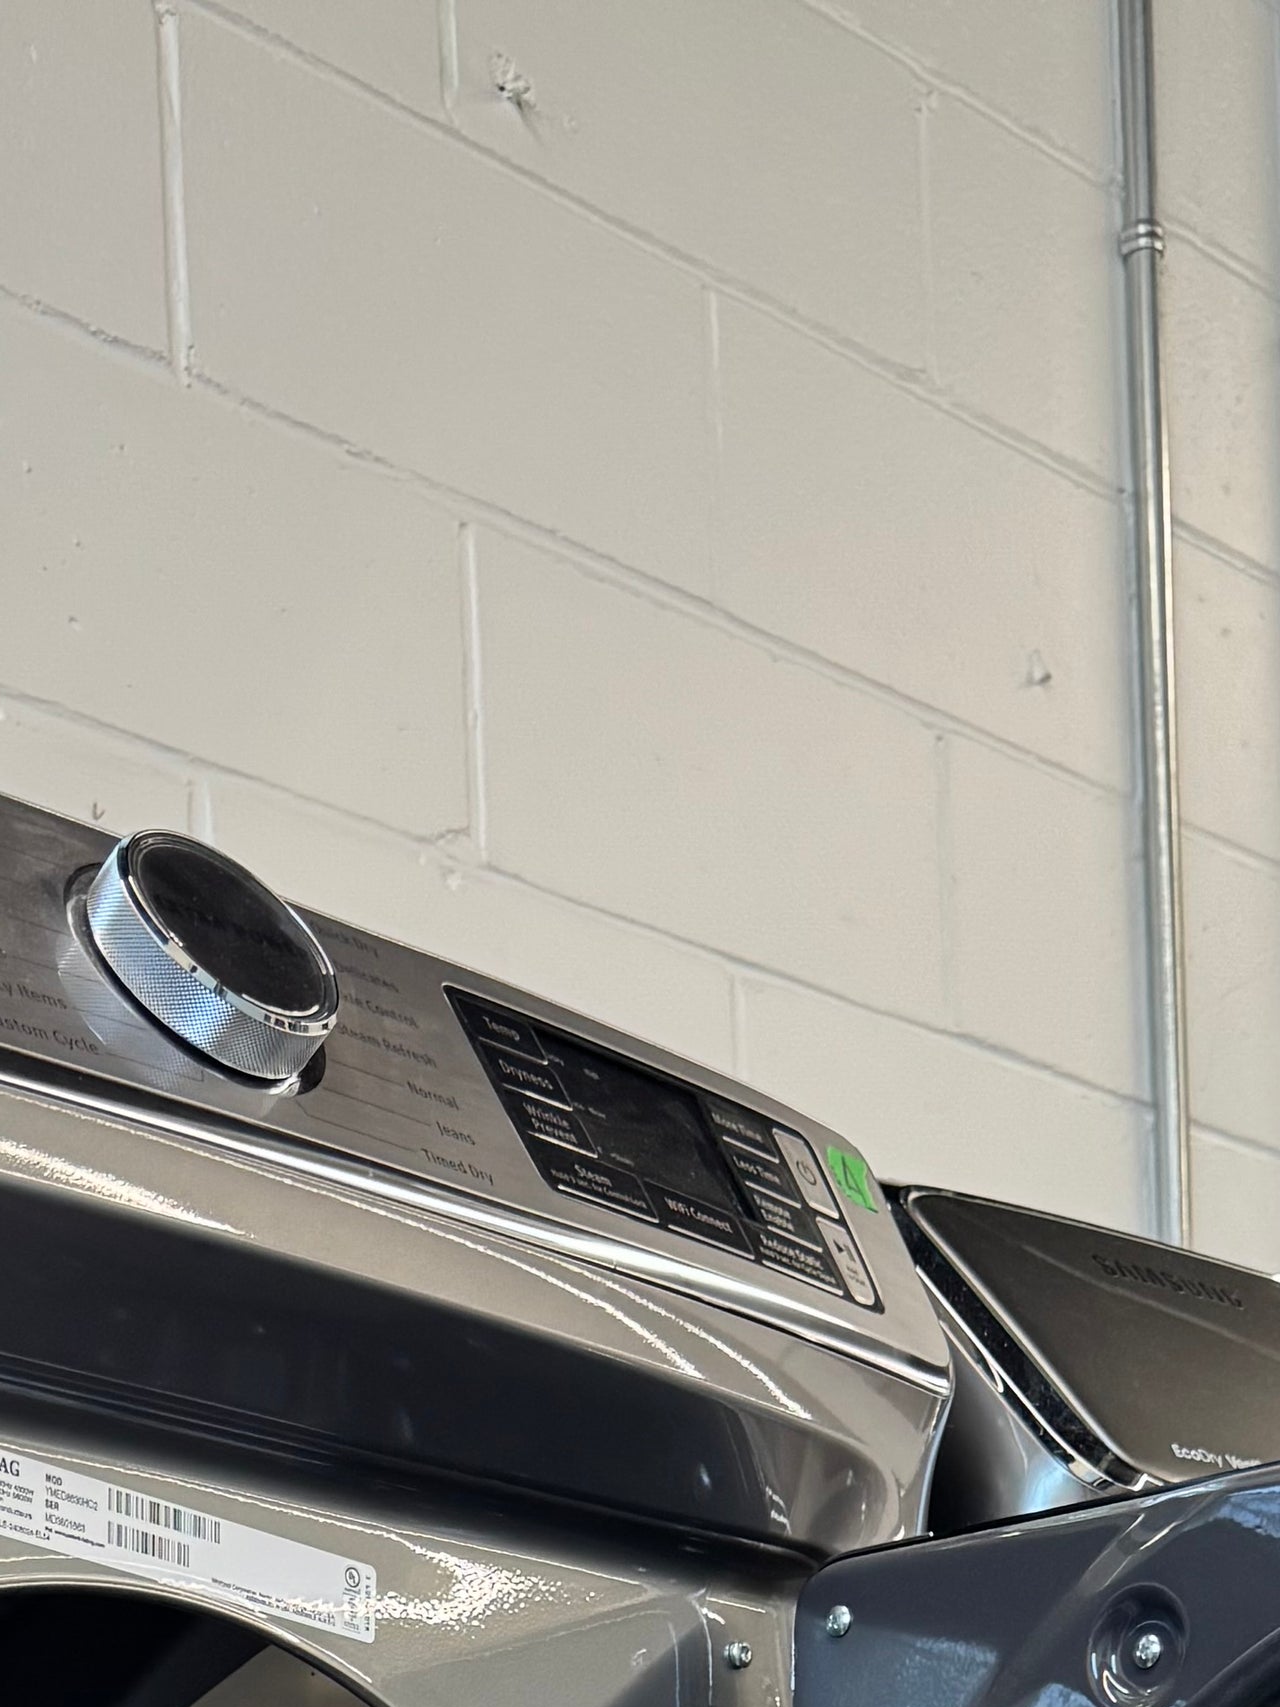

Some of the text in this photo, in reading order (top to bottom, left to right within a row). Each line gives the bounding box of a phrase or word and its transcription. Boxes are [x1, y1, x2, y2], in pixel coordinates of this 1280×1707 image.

[17, 983, 68, 1010] Items
[54, 1030, 101, 1056] Cycle
[483, 1016, 521, 1042] Temp
[498, 1058, 554, 1090] Dryness
[406, 1080, 460, 1110] Normal
[436, 1122, 476, 1146] Jeans
[422, 1148, 494, 1186] Timed Dry
[1092, 1253, 1245, 1310] SAMSUNG
